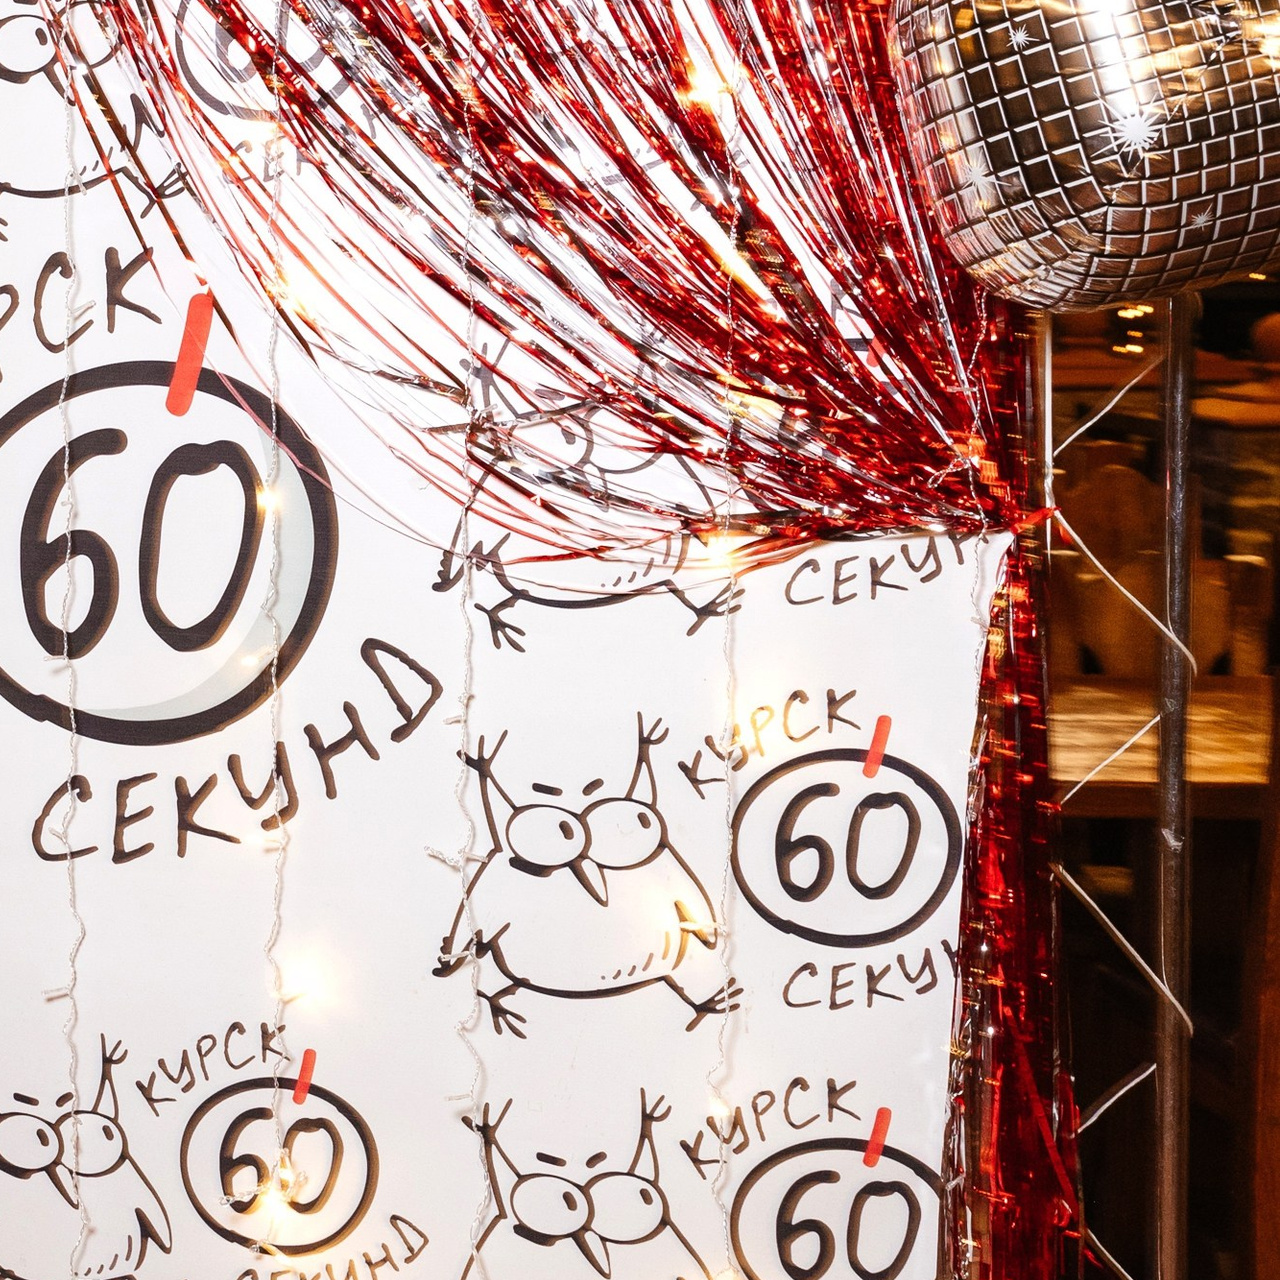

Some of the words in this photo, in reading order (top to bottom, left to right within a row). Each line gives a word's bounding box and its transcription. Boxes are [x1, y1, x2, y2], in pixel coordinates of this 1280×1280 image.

[20, 428, 266, 658] 60
[785, 531, 989, 607] СЕКУН
[31, 637, 443, 864] СЕКУНД
[678, 688, 861, 800] КУРСК
[775, 781, 921, 902] 60
[782, 939, 960, 1010] СЕКУ
[135, 1021, 291, 1117] КУРСК
[219, 1107, 344, 1214] 60
[679, 1077, 860, 1180] КУРСК
